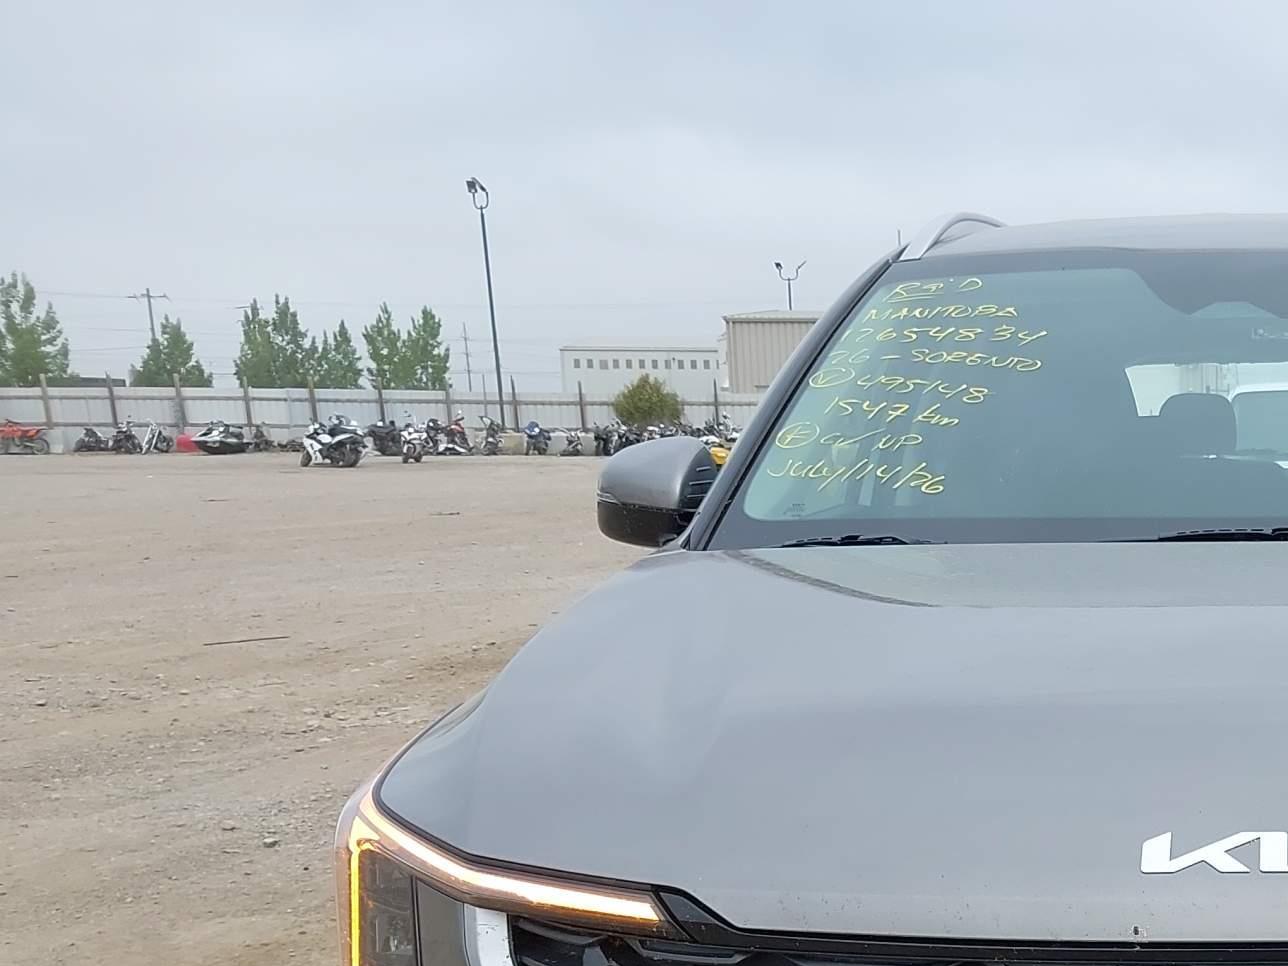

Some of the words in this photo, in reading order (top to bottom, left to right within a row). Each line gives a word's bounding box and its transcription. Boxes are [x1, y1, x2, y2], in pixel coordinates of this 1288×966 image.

[862, 304, 1018, 324] MANITOBA
[840, 325, 1048, 346] 12654834
[911, 349, 1042, 372] SORENTO
[857, 374, 989, 403] 495148
[824, 396, 911, 423] 1547
